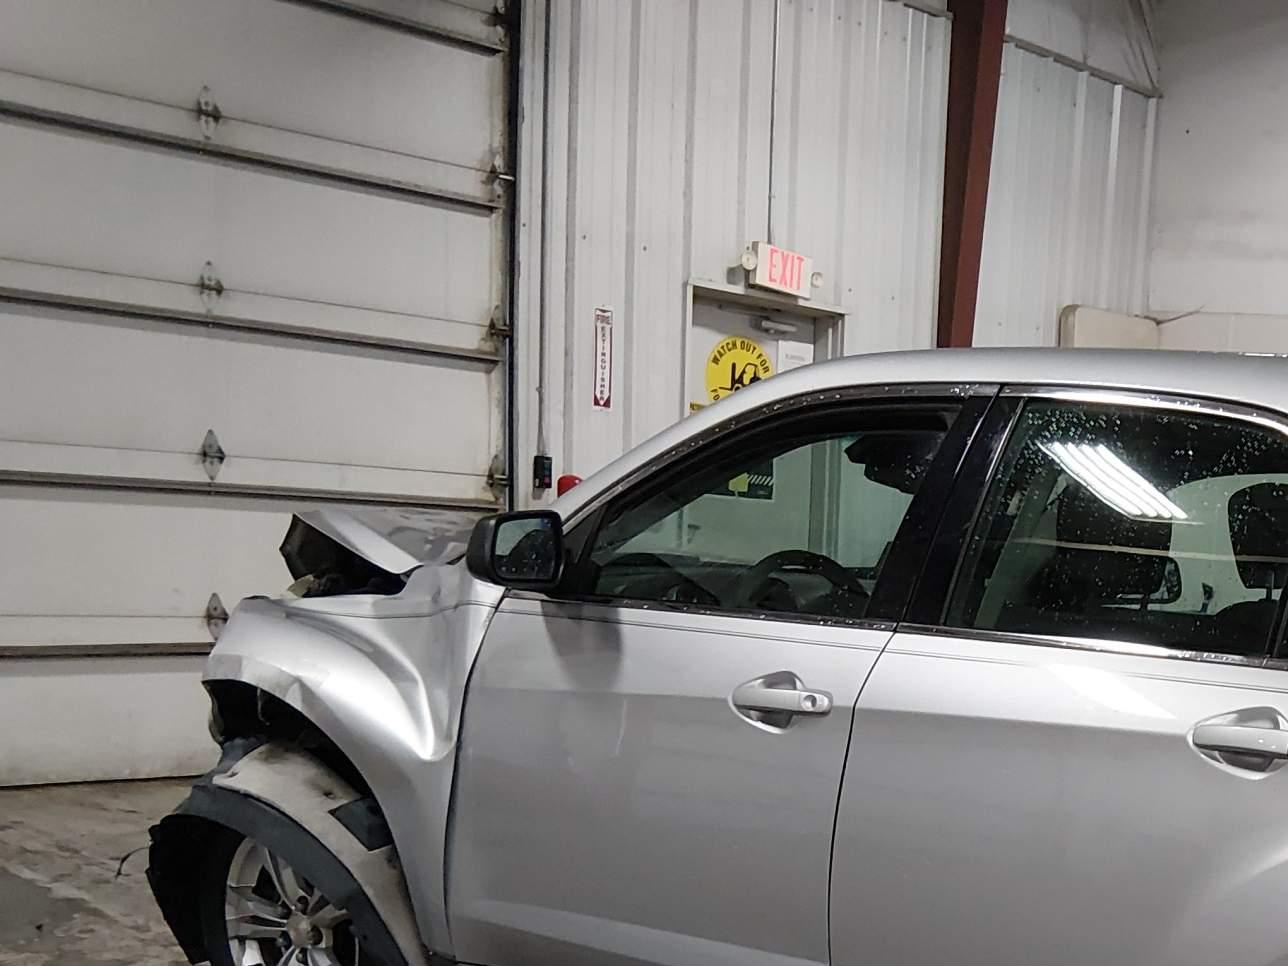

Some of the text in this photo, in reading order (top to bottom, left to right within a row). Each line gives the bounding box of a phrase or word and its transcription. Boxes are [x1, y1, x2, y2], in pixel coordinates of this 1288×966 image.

[768, 247, 805, 291] EXIT
[596, 314, 613, 325] FIRE
[599, 326, 607, 401] EXTINGUISHER
[711, 338, 738, 366] WATCH
[739, 340, 758, 355] OUT
[756, 353, 771, 374] FOR
